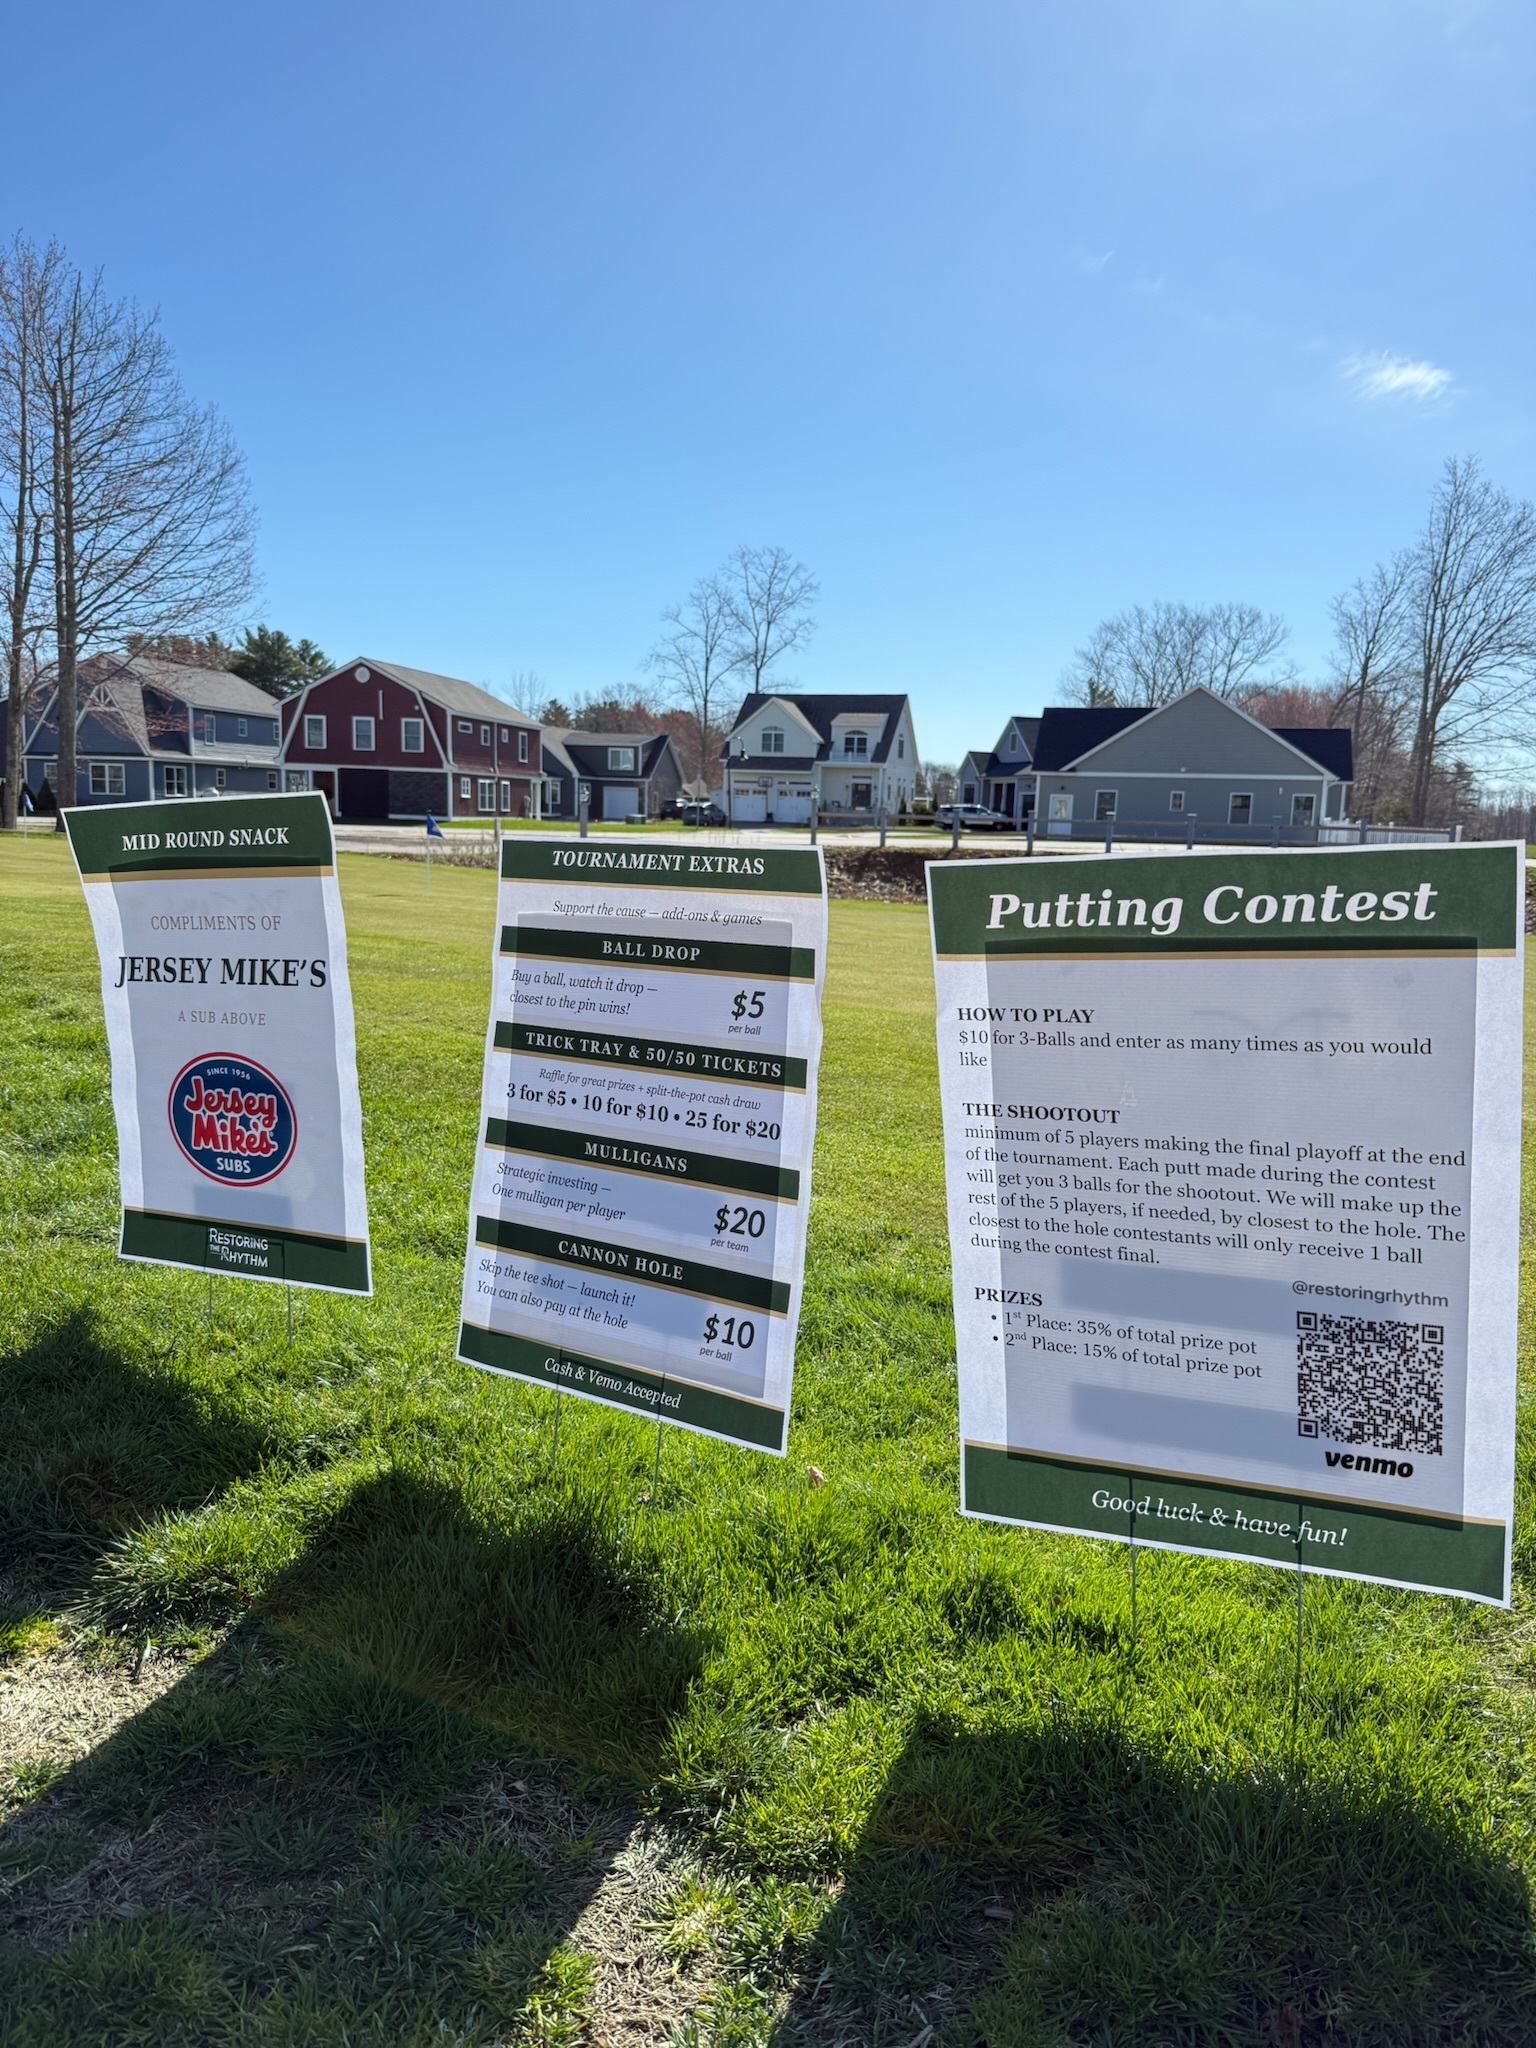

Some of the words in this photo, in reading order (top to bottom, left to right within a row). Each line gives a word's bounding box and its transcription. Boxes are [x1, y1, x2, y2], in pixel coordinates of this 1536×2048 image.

[122, 834, 160, 850] MID
[165, 830, 224, 848] ROUND
[229, 827, 289, 846] SNACK
[553, 850, 684, 871] TOURNAMENT
[689, 856, 764, 875] EXTRAS
[151, 915, 256, 930] COMPLIMENTS
[262, 916, 281, 930] OF
[553, 901, 594, 916] Support
[597, 903, 613, 916] the
[616, 907, 646, 918] cause
[662, 907, 707, 922] add-ons
[711, 911, 720, 922] &
[723, 913, 762, 926] games
[985, 888, 1184, 936] Putting
[1203, 882, 1438, 925] Contest
[602, 940, 645, 957] BALL
[652, 944, 700, 961] DROP
[115, 957, 212, 988] JERSEY
[220, 958, 326, 988] MIKE'S
[511, 969, 532, 985] Buy
[534, 975, 541, 984] a
[543, 972, 565, 988] ball,
[569, 975, 602, 990] watch
[605, 978, 613, 990] it
[616, 979, 644, 994] drop
[510, 992, 543, 1005] closest
[546, 995, 557, 1007] to
[559, 995, 575, 1009] the
[578, 998, 597, 1014] pin
[599, 1001, 630, 1015] wins!
[731, 990, 765, 1021] $5
[958, 1007, 1006, 1023] HOW
[1011, 1007, 1037, 1023] TO
[1043, 1008, 1094, 1024] PLAY
[178, 1011, 186, 1022] A
[191, 1011, 216, 1023] SUB
[221, 1012, 266, 1026] ABOVE
[728, 1024, 741, 1035] per
[743, 1024, 761, 1035] ball
[526, 1032, 574, 1050] TRICK
[580, 1040, 623, 1057] TRAY
[629, 1047, 639, 1059] &
[646, 1048, 695, 1067] 50/50
[702, 1054, 782, 1078] TICKETS
[958, 1031, 988, 1046] $10
[992, 1031, 1015, 1046] for
[1019, 1032, 1075, 1047] 3-Balls
[1080, 1032, 1112, 1047] and
[1116, 1035, 1161, 1049] enter
[1166, 1039, 1185, 1049] as
[1189, 1037, 1241, 1055] many
[1246, 1036, 1298, 1052] times
[1304, 1041, 1323, 1053] as
[1329, 1039, 1365, 1057] you
[1370, 1037, 1432, 1055] would
[207, 1068, 228, 1076] SINCE
[959, 1052, 987, 1067] like
[184, 1076, 278, 1128] Jersey
[539, 1068, 564, 1084] Raffle
[567, 1071, 580, 1086] for
[582, 1073, 605, 1089] great
[608, 1077, 634, 1093] prizes
[646, 1084, 705, 1102] split-the-pot
[708, 1092, 731, 1105] cash
[733, 1096, 760, 1110] draw
[506, 1083, 516, 1098] 3
[520, 1084, 543, 1102] for
[547, 1089, 566, 1107] $5
[583, 1094, 602, 1111] 10
[606, 1096, 631, 1116] for
[636, 1100, 668, 1122] $10
[686, 1109, 707, 1128] 25
[712, 1113, 741, 1133] for
[746, 1118, 780, 1141] $20
[963, 1103, 1002, 1117] THE
[1007, 1105, 1120, 1123] SHOOTOUT
[191, 1113, 278, 1156] Mike's
[965, 1126, 1040, 1142] minimum
[1045, 1129, 1060, 1143] of
[1066, 1131, 1074, 1143] 5
[1080, 1131, 1139, 1150] players
[1144, 1136, 1209, 1155] making
[1215, 1138, 1243, 1154] the
[1249, 1140, 1290, 1157] final
[1296, 1145, 1363, 1163] playoff
[1368, 1149, 1385, 1162] at
[1392, 1148, 1423, 1163] the
[1429, 1151, 1466, 1166] end
[217, 1157, 251, 1173] SUBS
[584, 1142, 688, 1172] MULLIGANS
[497, 1162, 545, 1185] Strategic
[548, 1172, 598, 1195] investing
[493, 1183, 513, 1198] One
[516, 1187, 564, 1209] mulligan
[566, 1198, 586, 1214] per
[588, 1201, 626, 1222] player
[714, 1204, 765, 1238] $20
[711, 1237, 723, 1248] per
[726, 1240, 749, 1252] team
[971, 1234, 1021, 1253] during
[1025, 1238, 1050, 1252] the
[1055, 1242, 1112, 1259] contest
[1117, 1247, 1159, 1263] final.
[558, 1240, 629, 1267] CANNON
[635, 1256, 684, 1281] HOLE
[479, 1259, 501, 1277] Skip
[504, 1265, 520, 1279] the
[523, 1270, 539, 1284] tee
[542, 1274, 564, 1291] shot
[580, 1282, 619, 1303] launch
[622, 1293, 635, 1307] it!
[975, 1286, 1043, 1307] PRIZES
[1292, 1280, 1449, 1308] @restoringrhythm
[477, 1281, 496, 1297] You
[498, 1288, 518, 1301] can
[521, 1291, 542, 1307] also
[545, 1300, 566, 1318] pay
[569, 1305, 580, 1315] at
[582, 1305, 601, 1322] the
[603, 1311, 627, 1329] hole
[703, 1314, 754, 1349] $10
[1005, 1310, 1021, 1325] 1st
[1027, 1314, 1072, 1332] Place:
[1077, 1319, 1112, 1337] 35%
[1117, 1325, 1134, 1339] of
[1137, 1328, 1176, 1344] total
[1181, 1333, 1223, 1351] prize
[1228, 1338, 1257, 1355] pot
[699, 1346, 712, 1358] per
[715, 1349, 732, 1361] ball
[1005, 1332, 1027, 1346] 2nd
[1032, 1335, 1077, 1354] Place:
[1083, 1342, 1117, 1360] 15%
[1122, 1348, 1139, 1362] of
[1143, 1352, 1181, 1367] total
[1186, 1356, 1228, 1374] prize
[1234, 1361, 1262, 1379] pot
[544, 1357, 573, 1380] Cash
[575, 1366, 586, 1380] &
[590, 1370, 621, 1392] Vemo
[623, 1381, 682, 1409] Accepted
[1325, 1452, 1414, 1478] venmo
[1092, 1489, 1150, 1517] Good
[1157, 1497, 1203, 1524] luck
[1210, 1507, 1227, 1527] &
[1234, 1508, 1291, 1537] have
[1296, 1520, 1348, 1547] fun!
